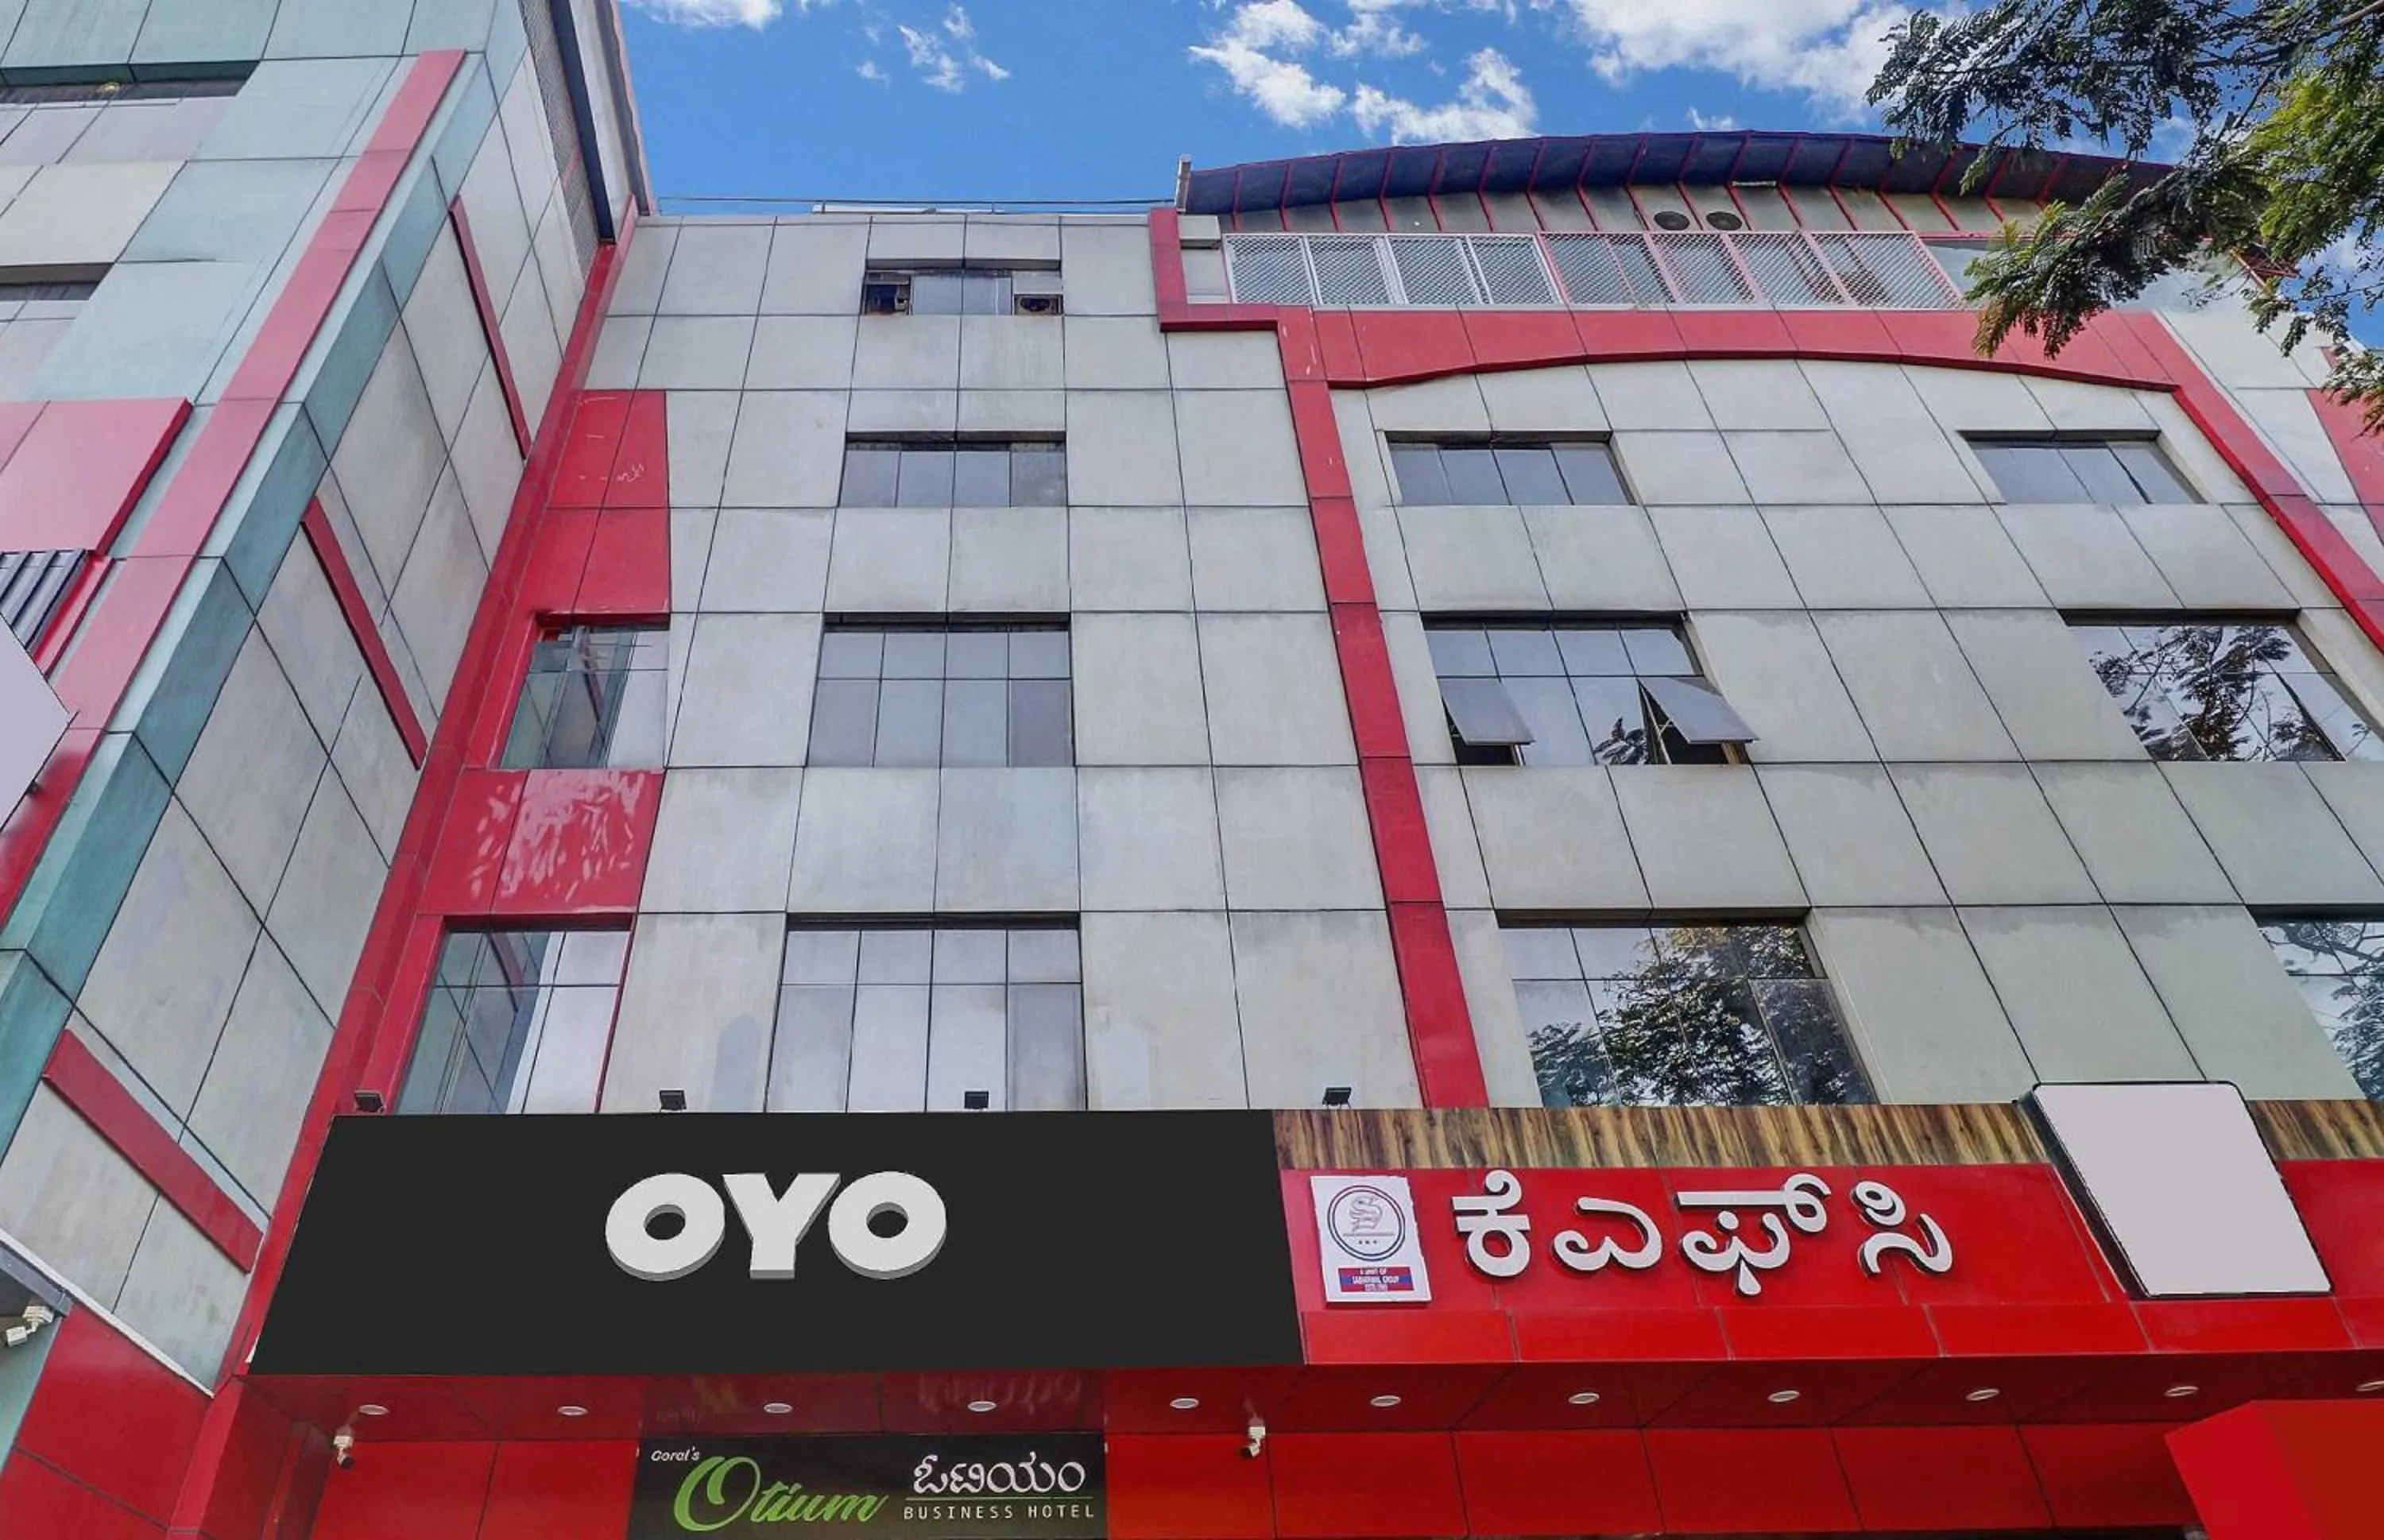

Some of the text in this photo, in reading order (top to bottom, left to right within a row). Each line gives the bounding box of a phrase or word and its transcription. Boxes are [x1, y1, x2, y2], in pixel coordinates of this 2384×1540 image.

[606, 1171, 946, 1280] OYO
[674, 1456, 888, 1531] Otium
[904, 1503, 1094, 1519] BUSINESS HOTEL
